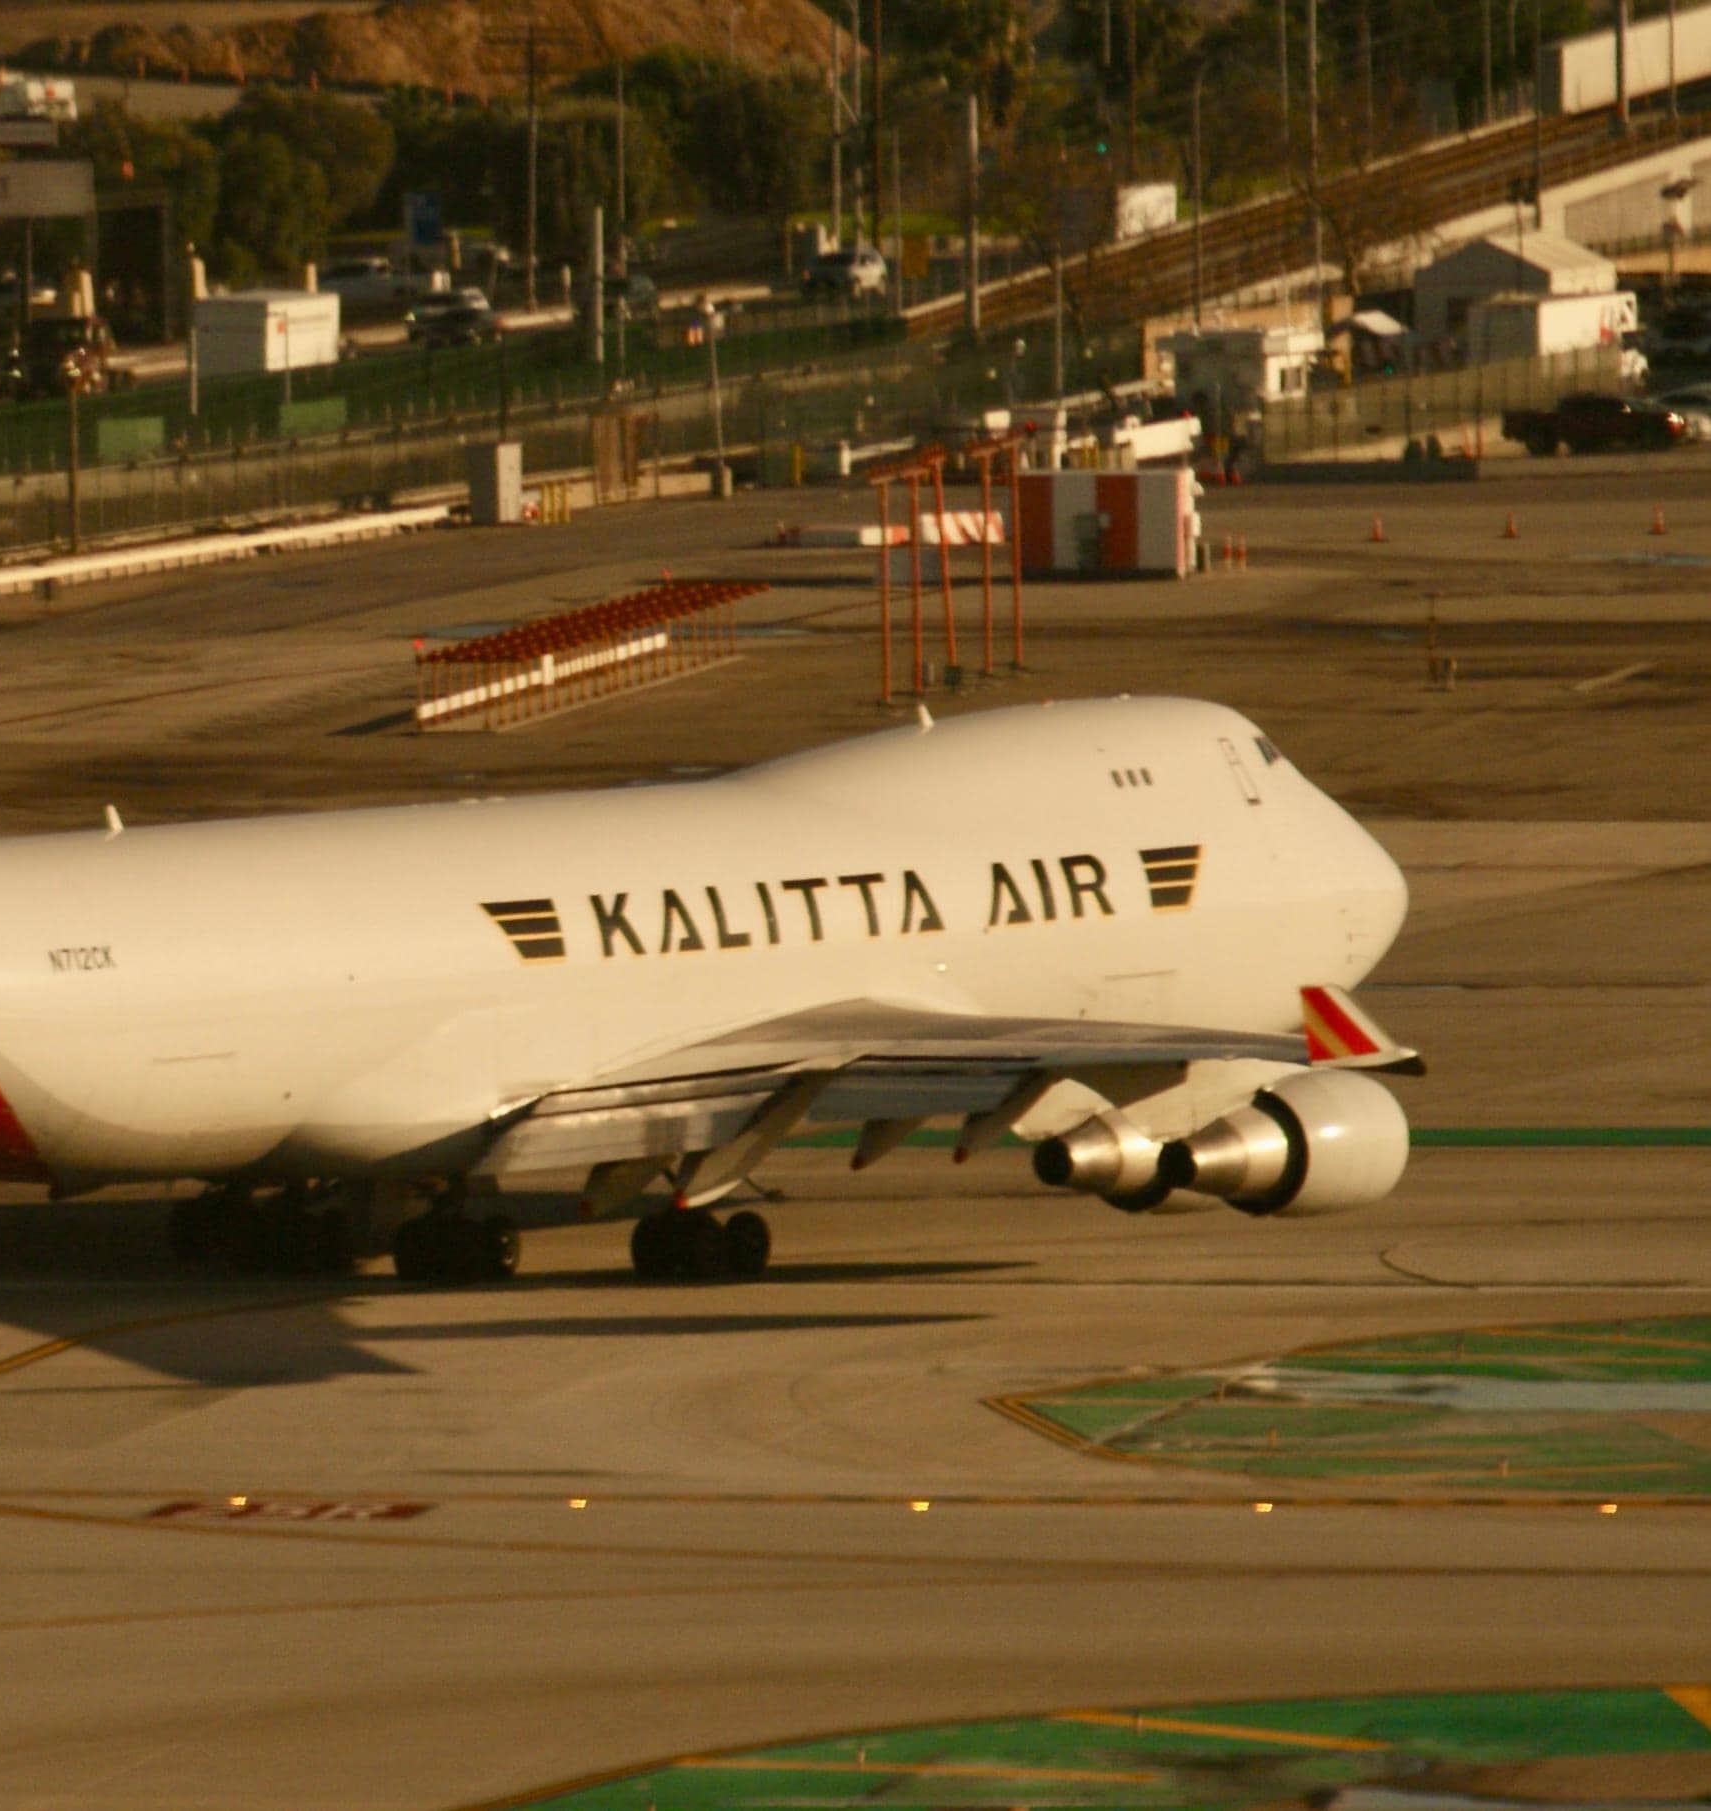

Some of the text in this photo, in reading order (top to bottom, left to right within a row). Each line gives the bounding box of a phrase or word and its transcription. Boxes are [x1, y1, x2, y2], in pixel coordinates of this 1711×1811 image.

[588, 853, 1115, 959] KALITTA AIR
[47, 945, 117, 973] N712CK
